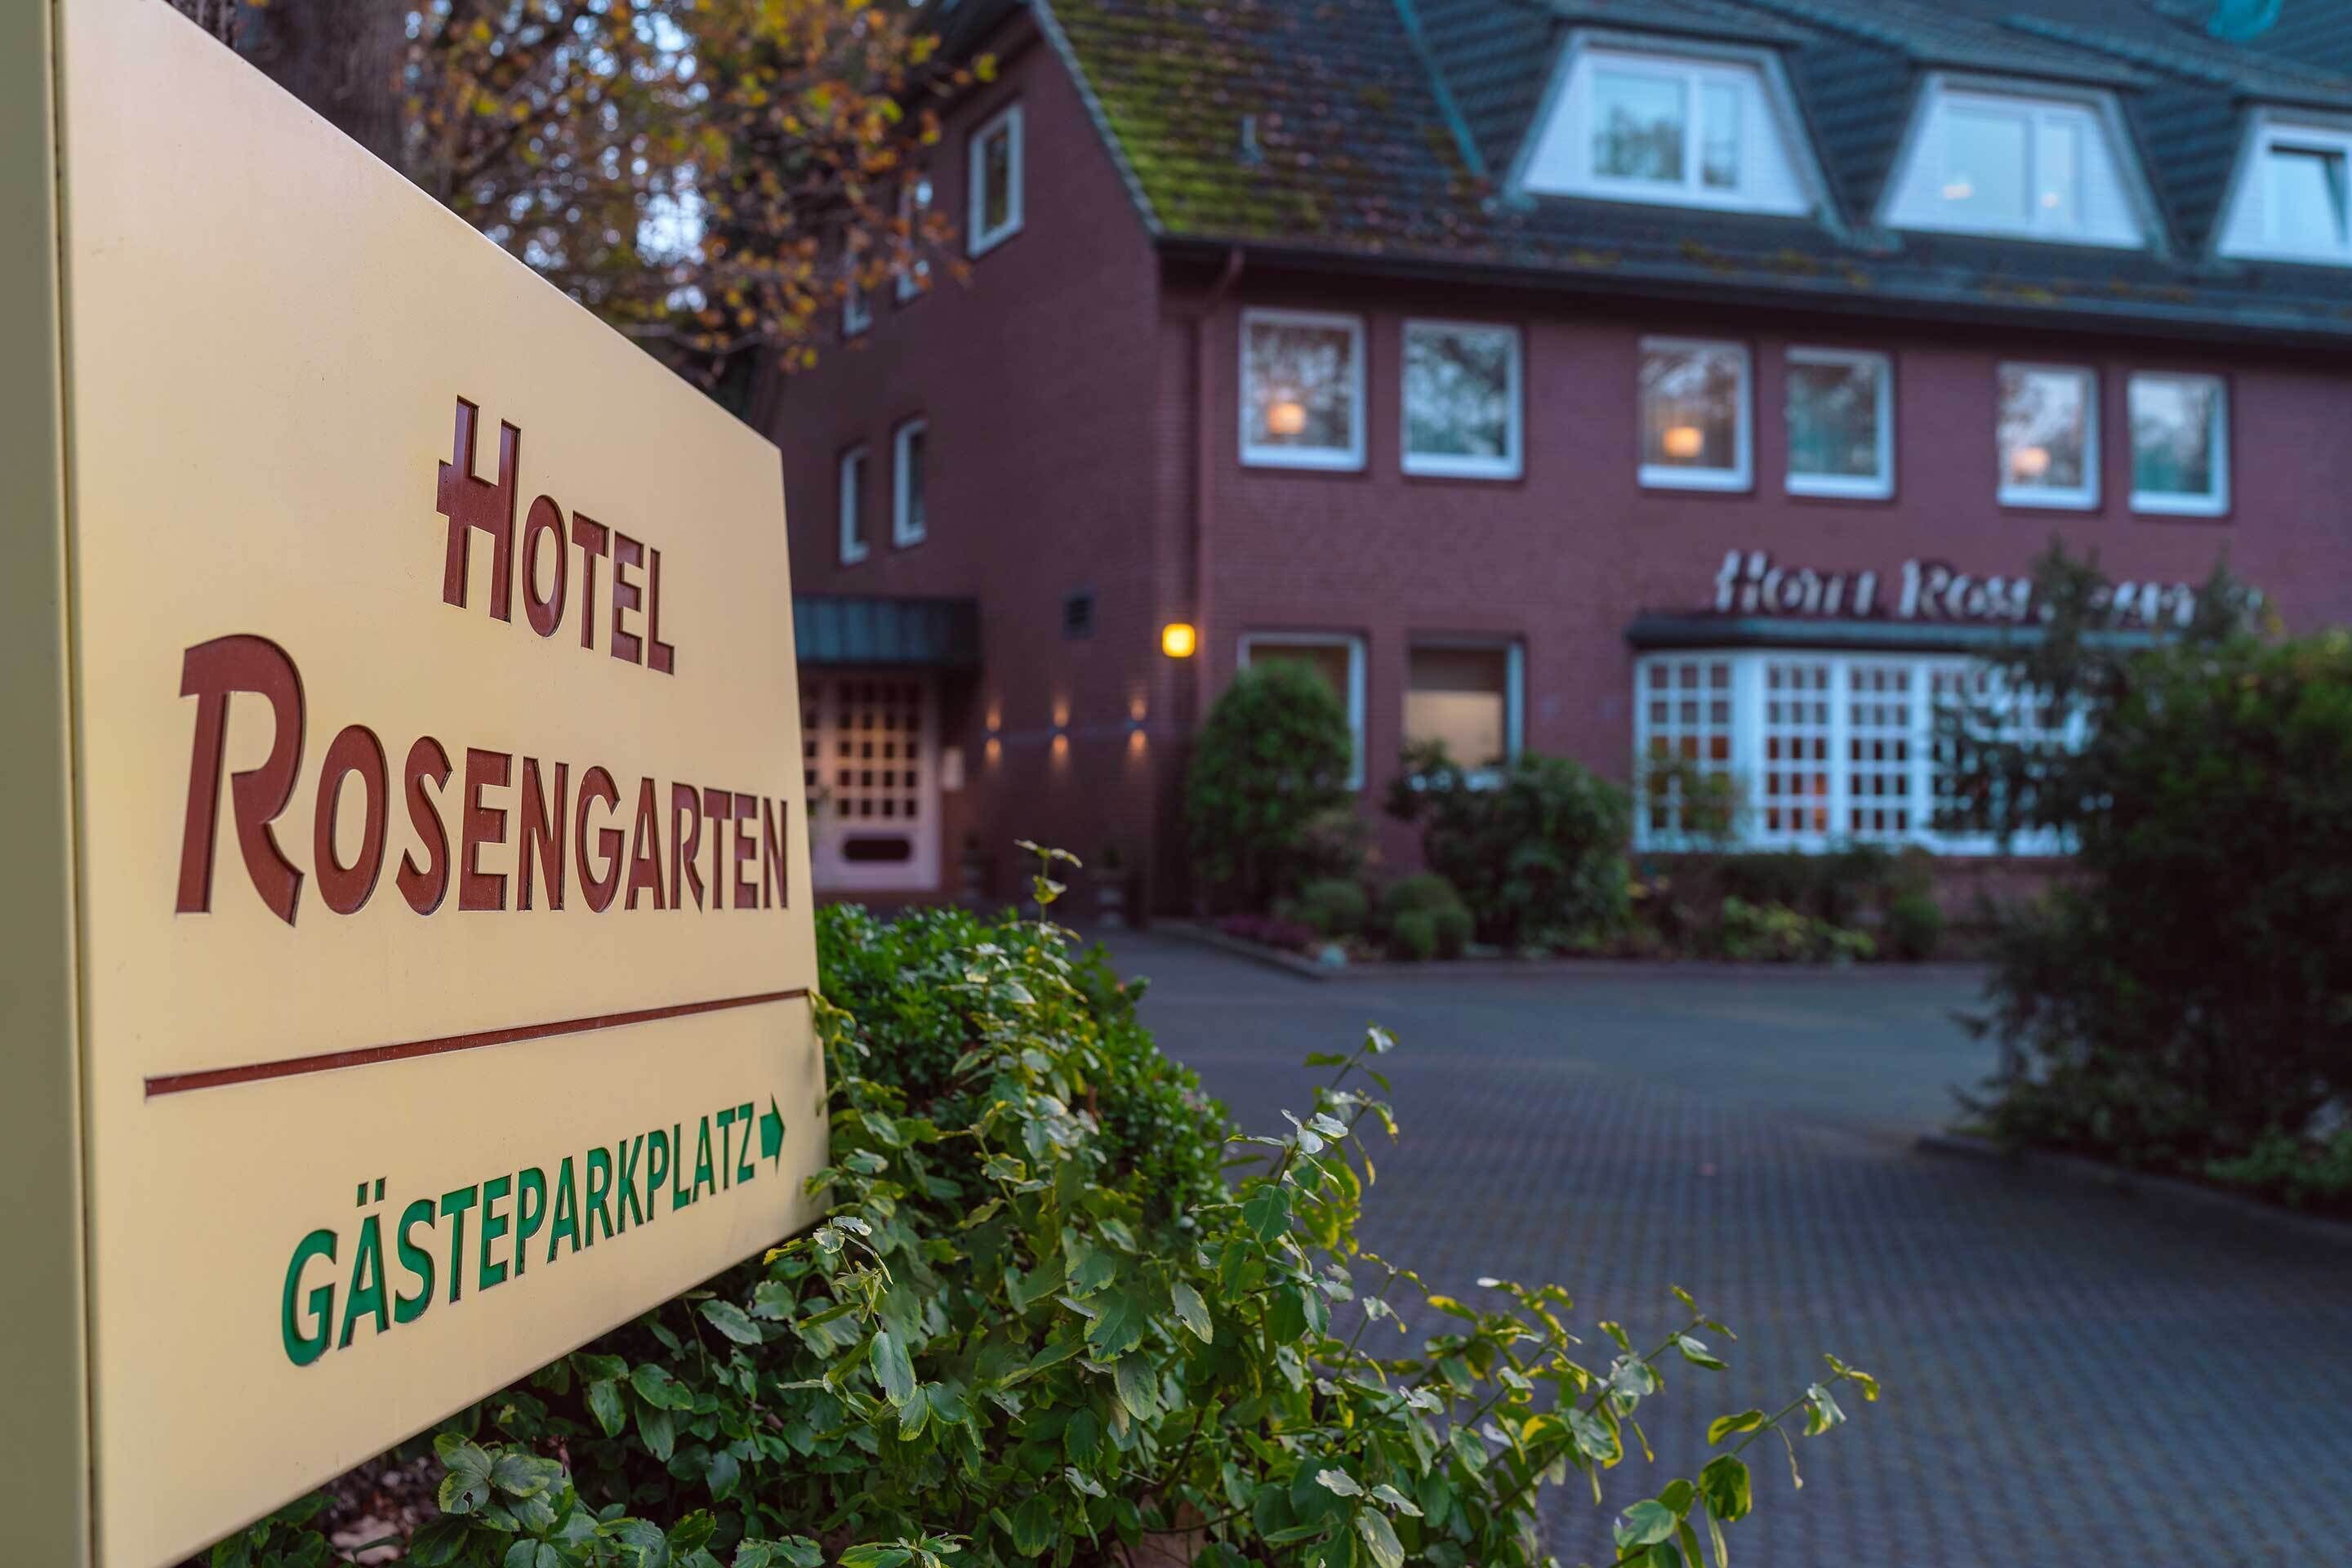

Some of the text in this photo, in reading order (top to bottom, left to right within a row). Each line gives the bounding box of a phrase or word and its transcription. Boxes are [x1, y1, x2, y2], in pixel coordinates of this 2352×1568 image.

[436, 395, 675, 675] HOTEL
[176, 634, 789, 927] ROSENGARTEN
[282, 1102, 755, 1366] GÄSTEPARKPLATZ
